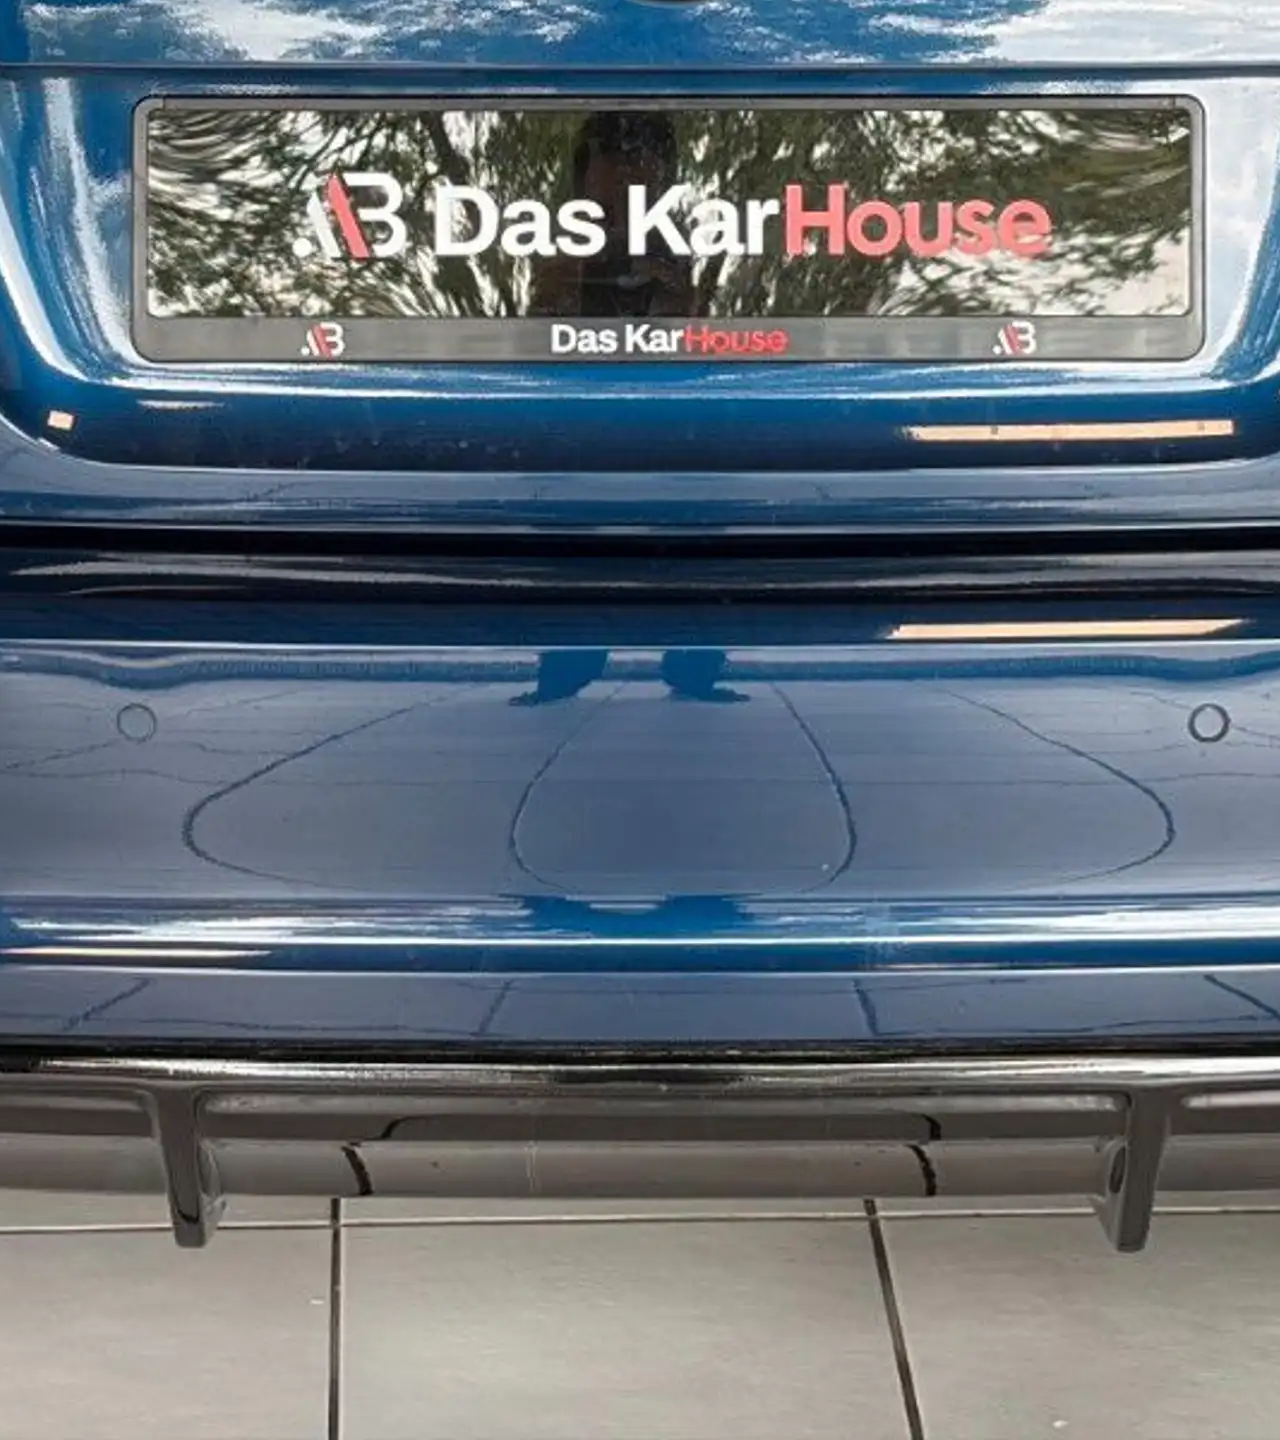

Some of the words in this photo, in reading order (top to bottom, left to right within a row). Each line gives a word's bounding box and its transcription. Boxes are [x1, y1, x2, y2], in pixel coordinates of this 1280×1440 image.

[433, 184, 606, 257] Das
[627, 184, 1051, 257] KarHouse
[551, 324, 616, 354] Das
[625, 324, 788, 354] KarHouse
